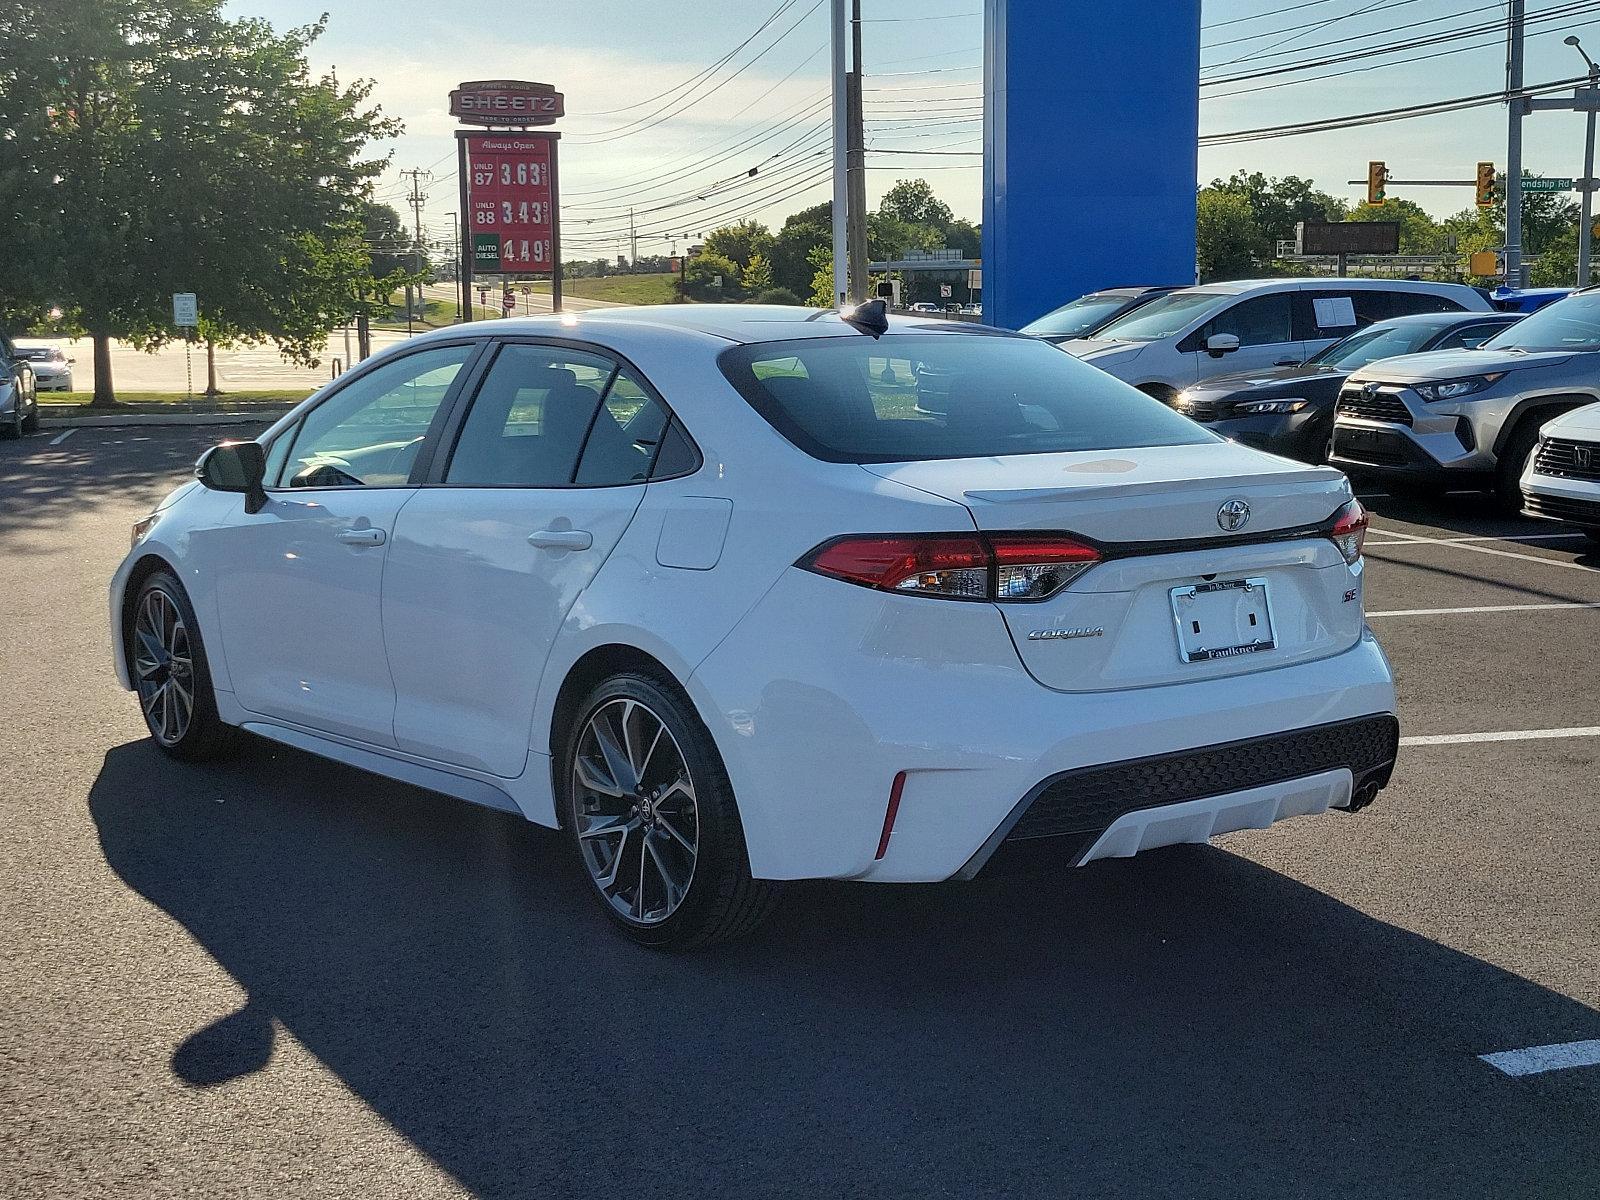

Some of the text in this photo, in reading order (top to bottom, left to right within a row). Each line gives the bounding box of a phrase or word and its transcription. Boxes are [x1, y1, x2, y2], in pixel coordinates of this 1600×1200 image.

[461, 96, 555, 111] SHEETZ
[482, 141, 535, 150] Always Open
[474, 173, 494, 186] 87
[501, 163, 541, 186] 3.63
[1521, 180, 1569, 189] endship Rd
[476, 211, 496, 224] 88
[502, 201, 542, 224] 3.43
[1208, 645, 1257, 659] Faulkner
